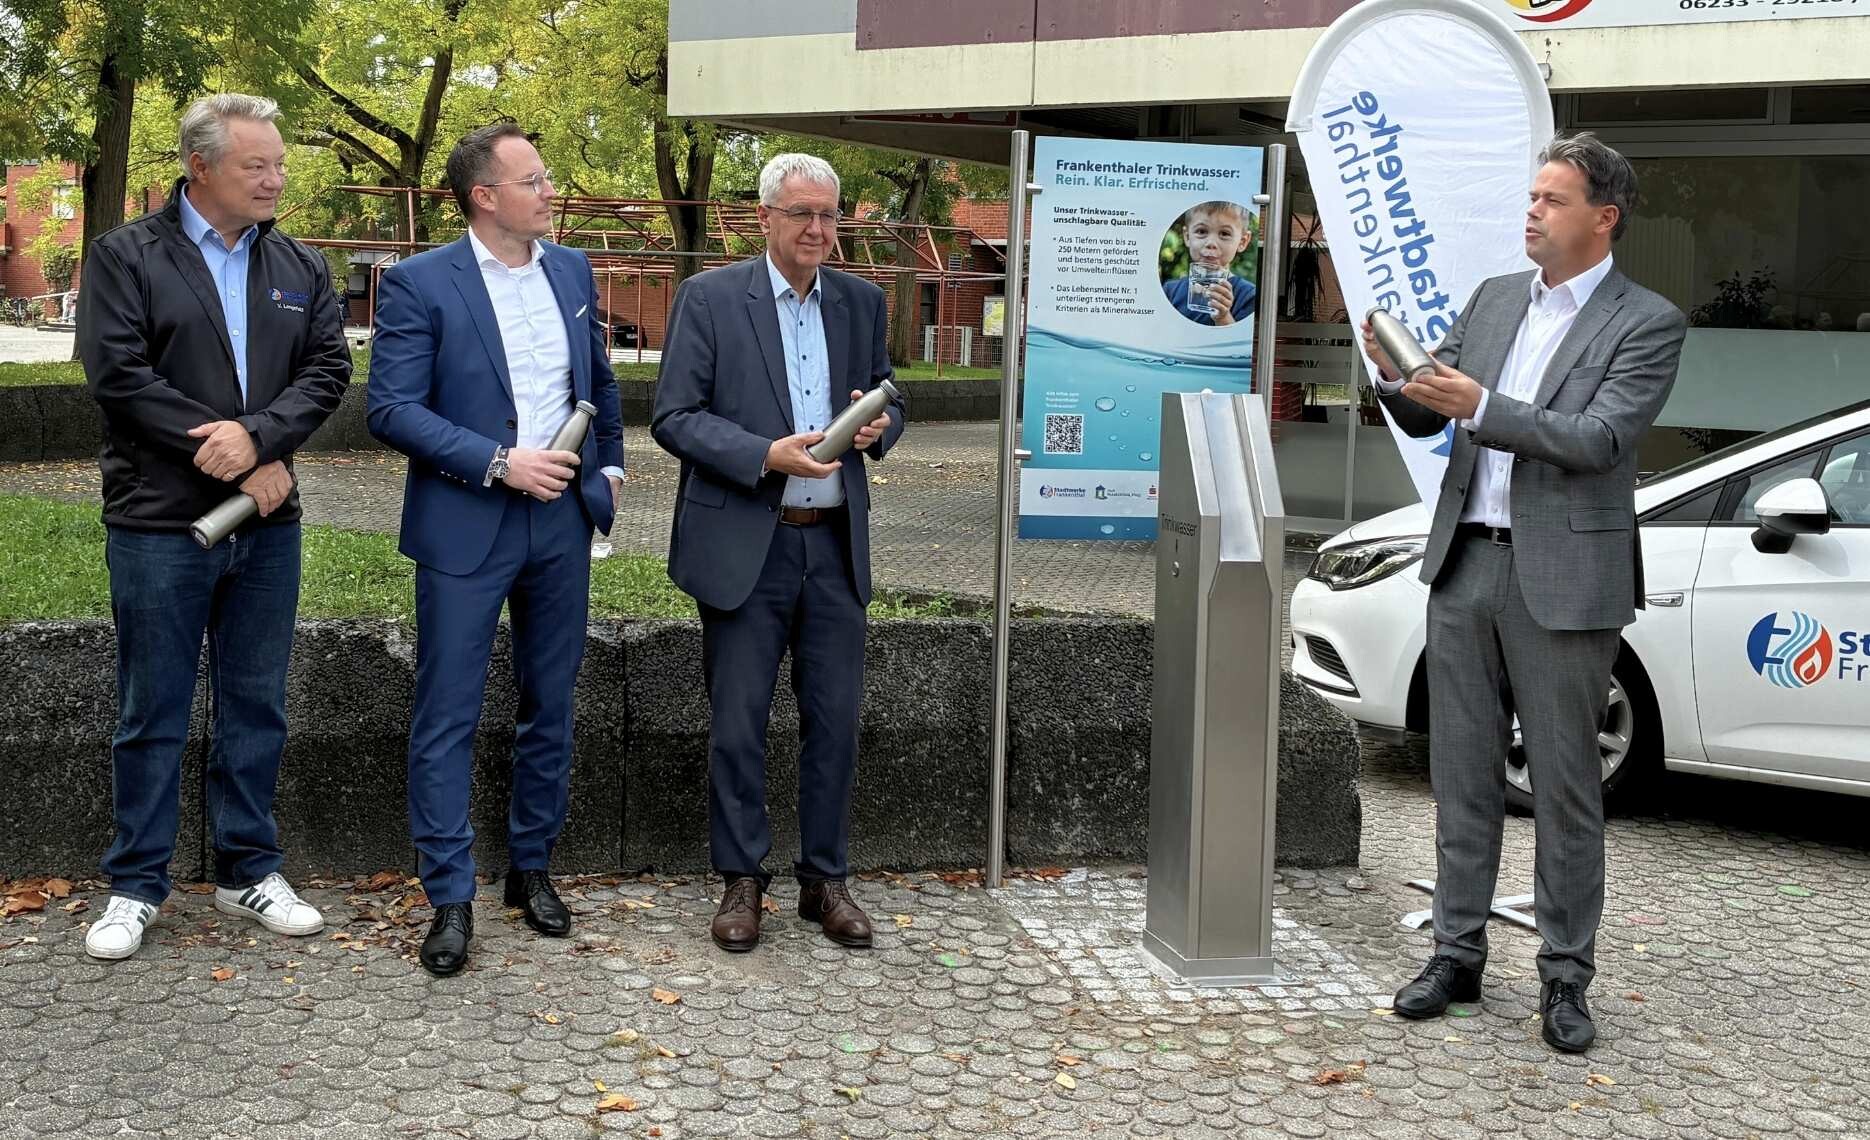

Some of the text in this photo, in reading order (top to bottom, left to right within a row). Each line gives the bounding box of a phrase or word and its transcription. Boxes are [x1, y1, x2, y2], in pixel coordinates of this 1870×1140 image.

[1056, 159, 1241, 179] Frankenthaler Trinkwasser:
[1055, 174, 1209, 191] Rein. Klar. Erfrischend.
[1053, 206, 1078, 214] Unser
[1079, 207, 1129, 216] Trinkwasser
[1053, 217, 1147, 227] unschlagbare Qualität:
[1075, 236, 1098, 245] Tiefen
[1115, 237, 1126, 245] bis
[1058, 245, 1139, 256] 250 Metern gefördert
[1074, 256, 1102, 264] bestens
[1104, 257, 1140, 267] geschützt
[1071, 265, 1137, 275] Umwelteinflüssen
[1056, 284, 1070, 292] Das
[1071, 285, 1120, 294] Lebensmittel
[1056, 294, 1135, 305] unterliegt strengeren
[1055, 304, 1155, 315] Kriterien als Mineralwasser
